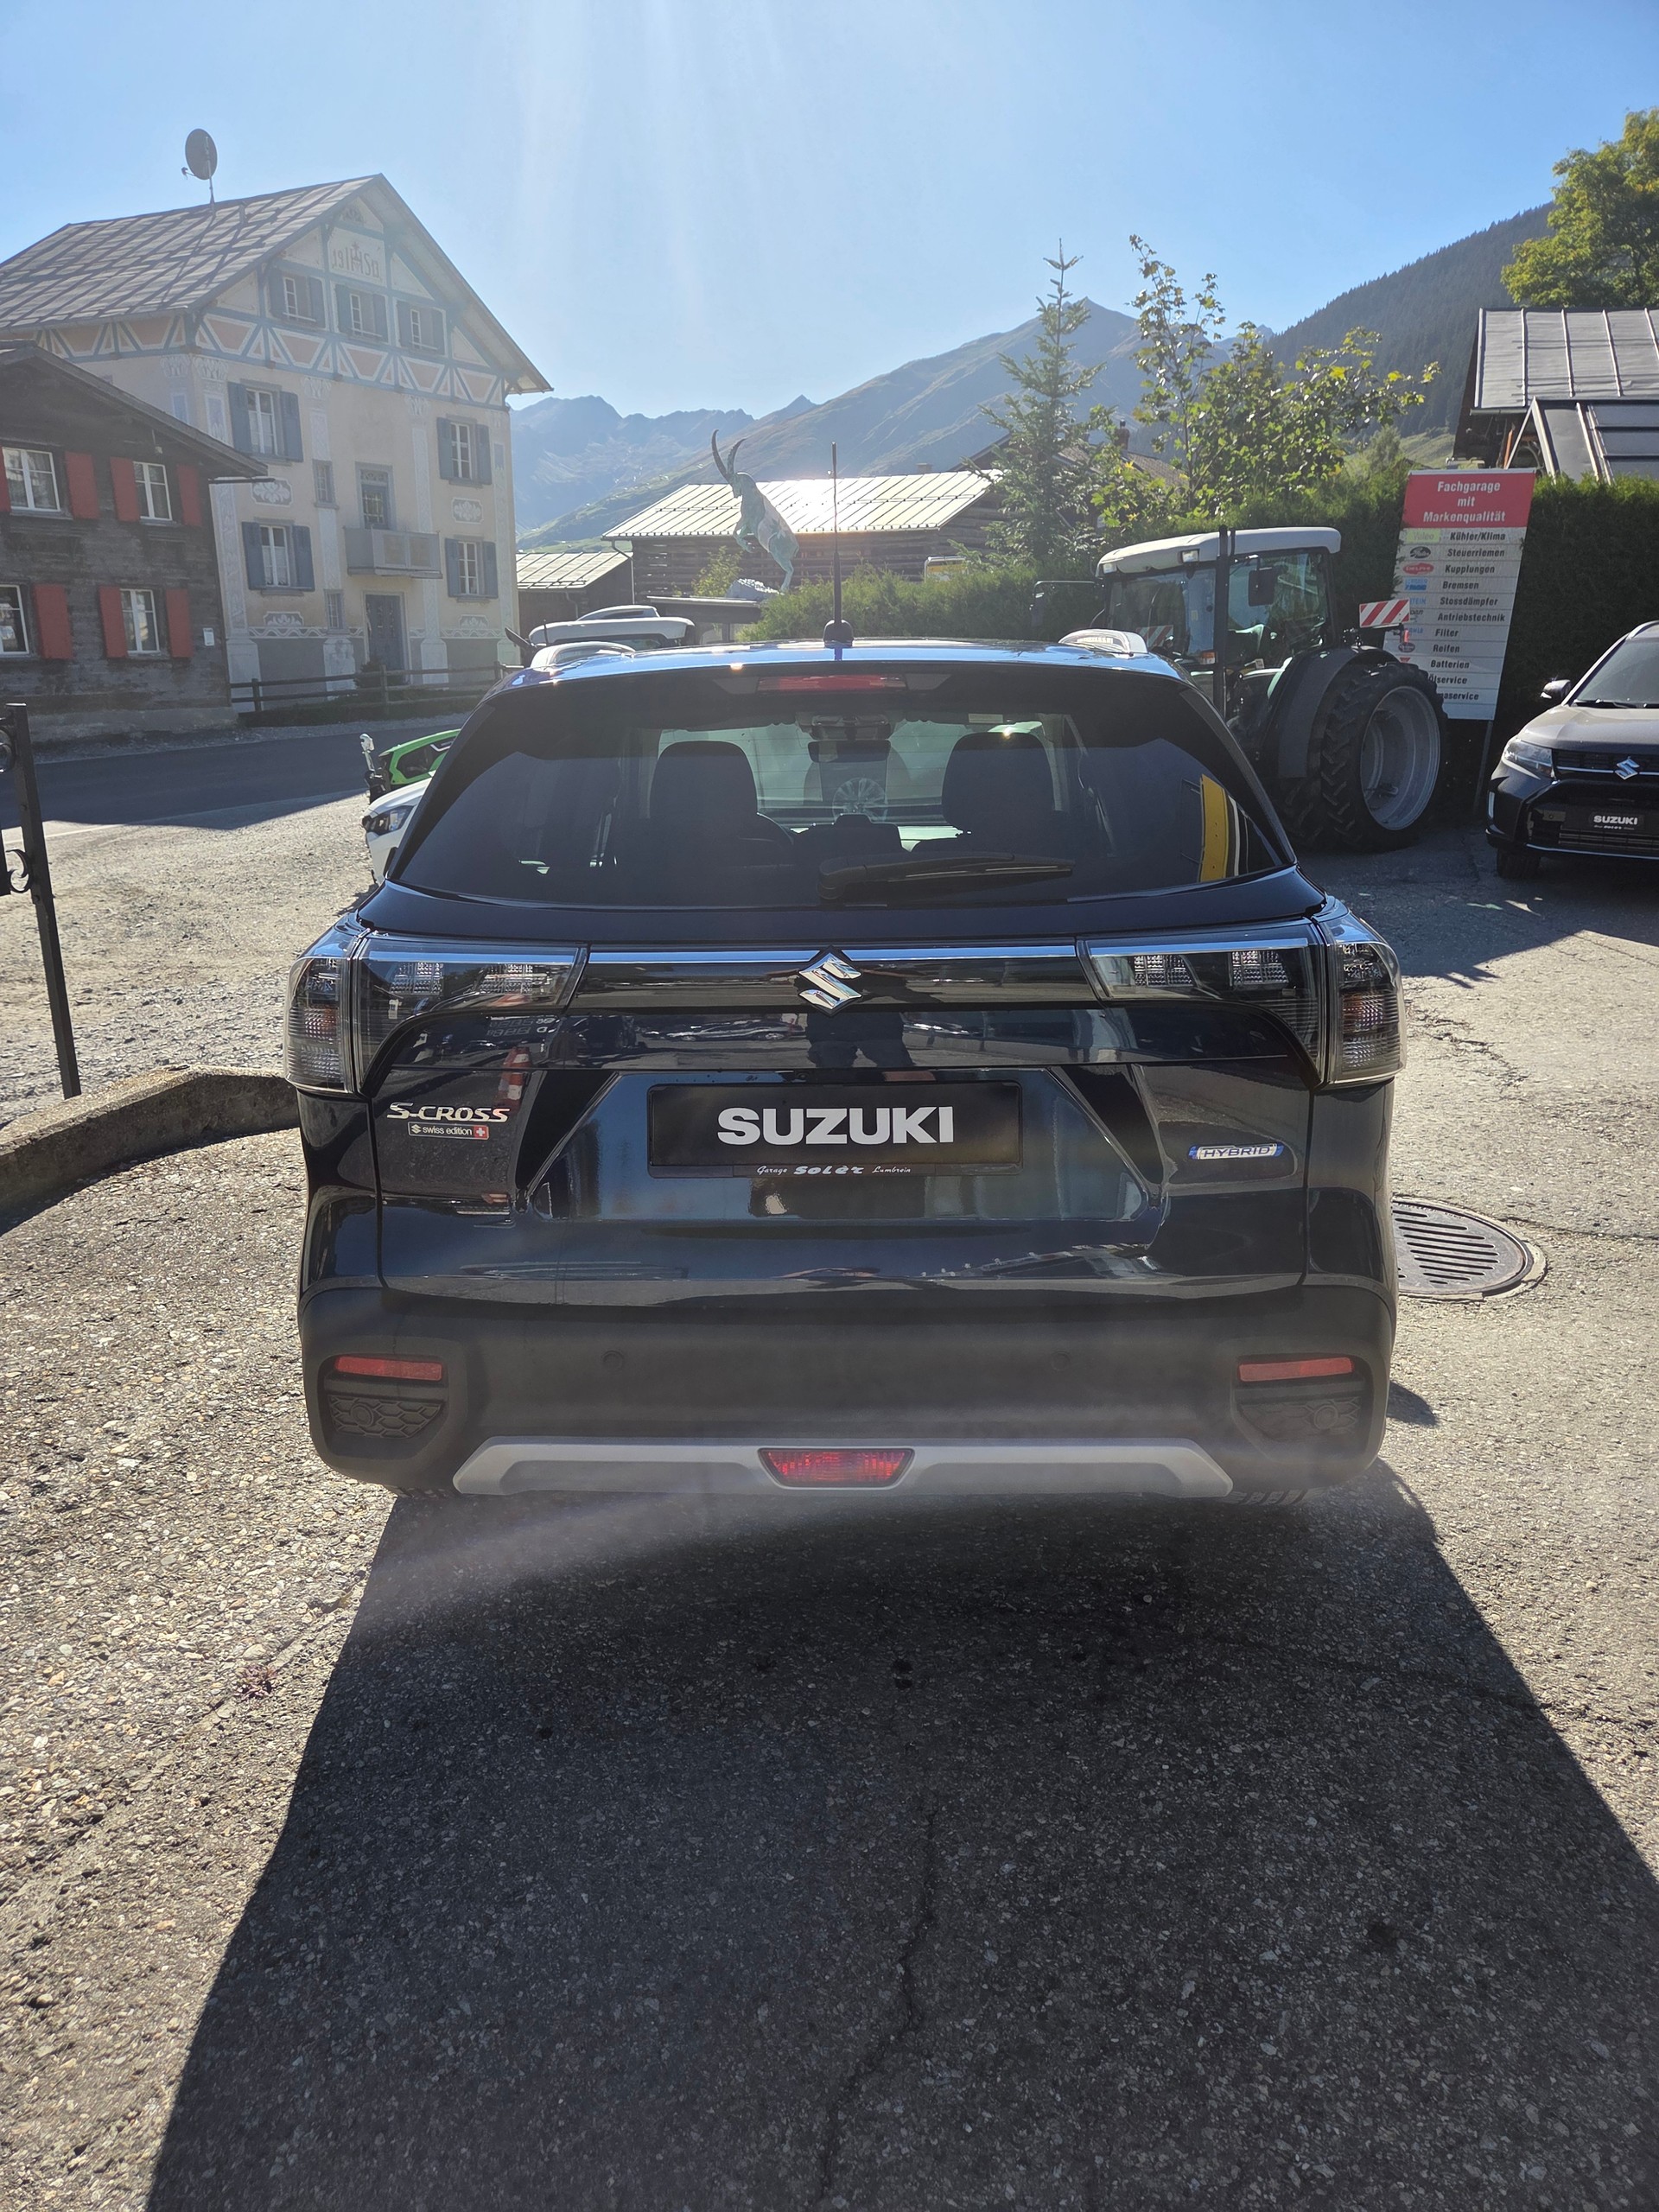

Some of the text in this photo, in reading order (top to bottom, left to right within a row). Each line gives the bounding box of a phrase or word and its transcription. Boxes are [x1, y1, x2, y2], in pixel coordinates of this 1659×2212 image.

[1437, 481, 1501, 493] Fachgarage
[1457, 496, 1475, 507] mit
[1422, 511, 1506, 524] Markenqualität
[1450, 531, 1506, 541] Kühler/Klima
[1446, 548, 1505, 557] Steuerriemen
[1445, 564, 1495, 575] Kupplungen
[1442, 581, 1479, 589] Bremsen
[1440, 596, 1498, 607] Stossdämpfer
[1437, 613, 1506, 622] Antriebstechnik
[1434, 628, 1459, 637] Filter
[1433, 644, 1460, 652] Reifen
[1430, 659, 1471, 669] Batterien
[1593, 815, 1638, 825] SUZUKI
[386, 1102, 511, 1122] S-CROSS
[423, 1125, 473, 1135] swiss edition
[716, 1105, 954, 1146] SUZUKI
[1203, 1147, 1270, 1158] HYBRID
[756, 1165, 788, 1176] Garage
